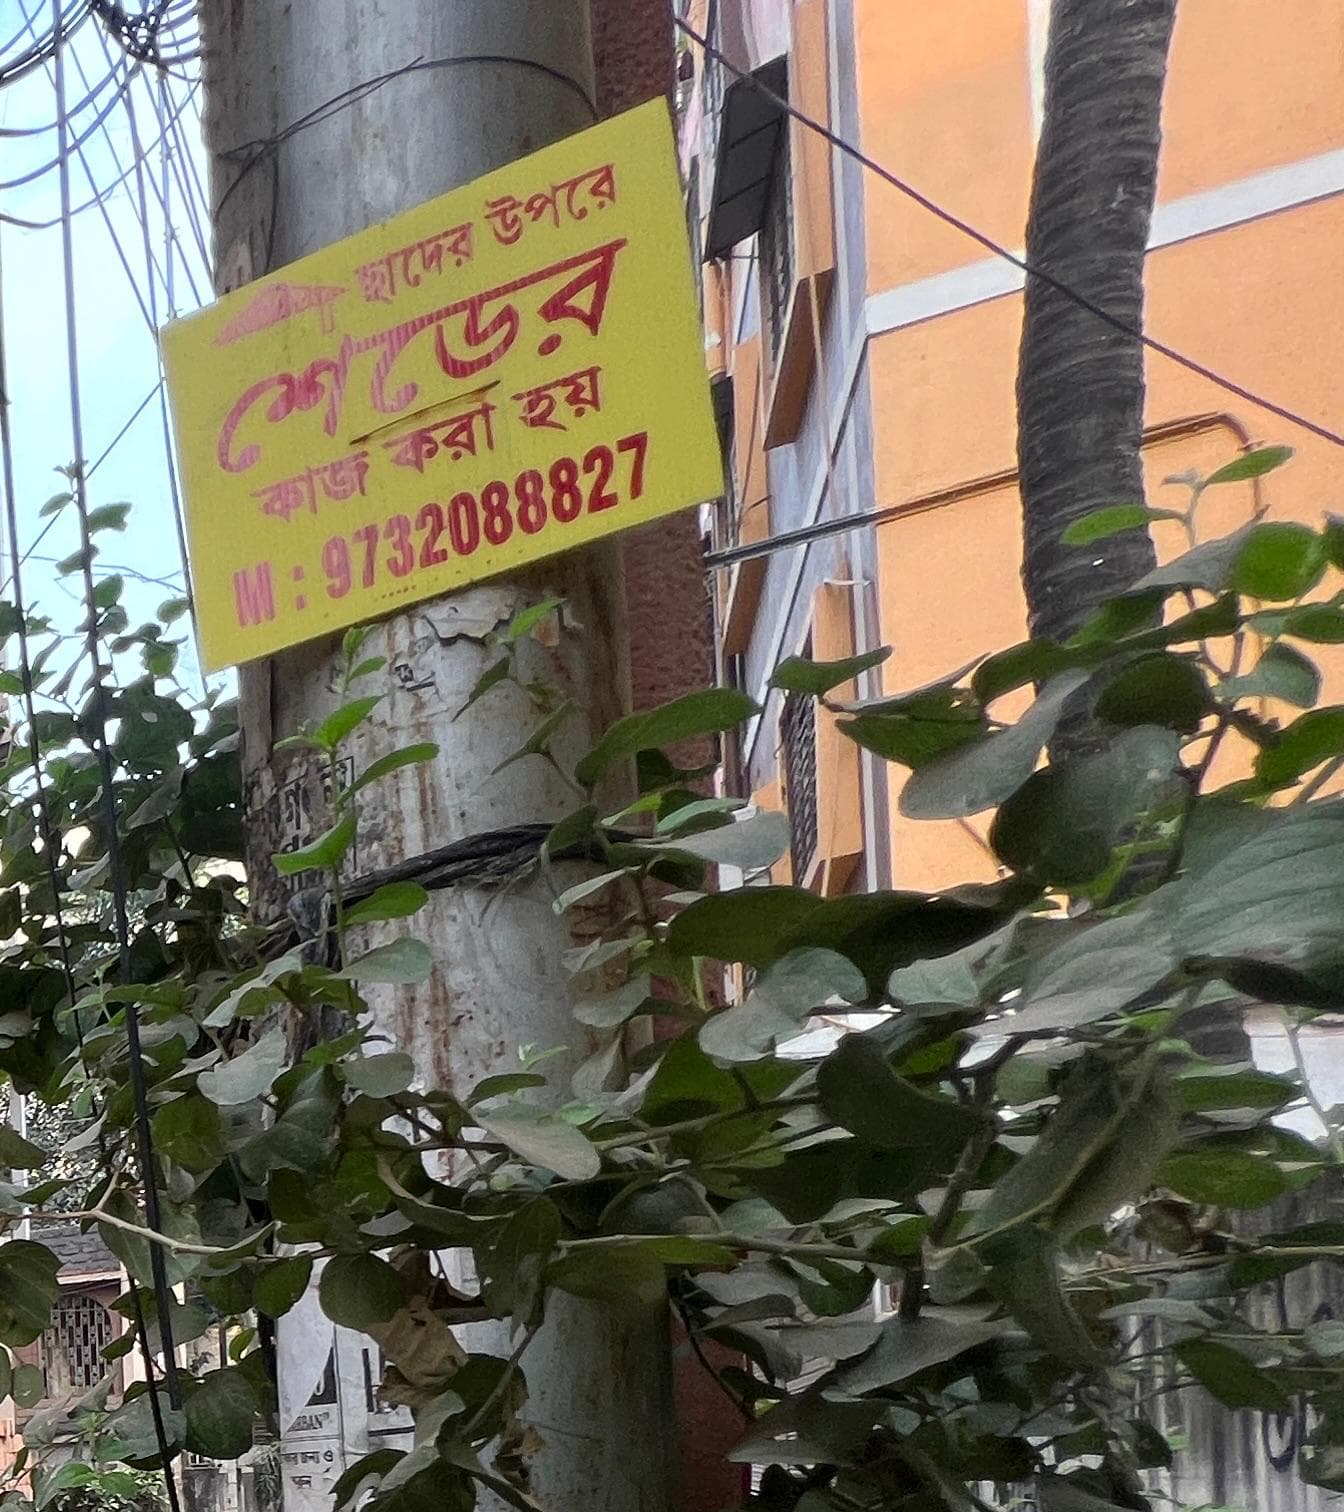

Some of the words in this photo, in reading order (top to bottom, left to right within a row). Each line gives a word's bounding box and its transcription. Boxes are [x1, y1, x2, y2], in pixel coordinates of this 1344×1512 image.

[484, 163, 617, 248] উপরে
[251, 449, 371, 523] কাজ
[383, 401, 497, 474] করা
[512, 365, 603, 432] হয়
[320, 432, 651, 600] 9732088827
